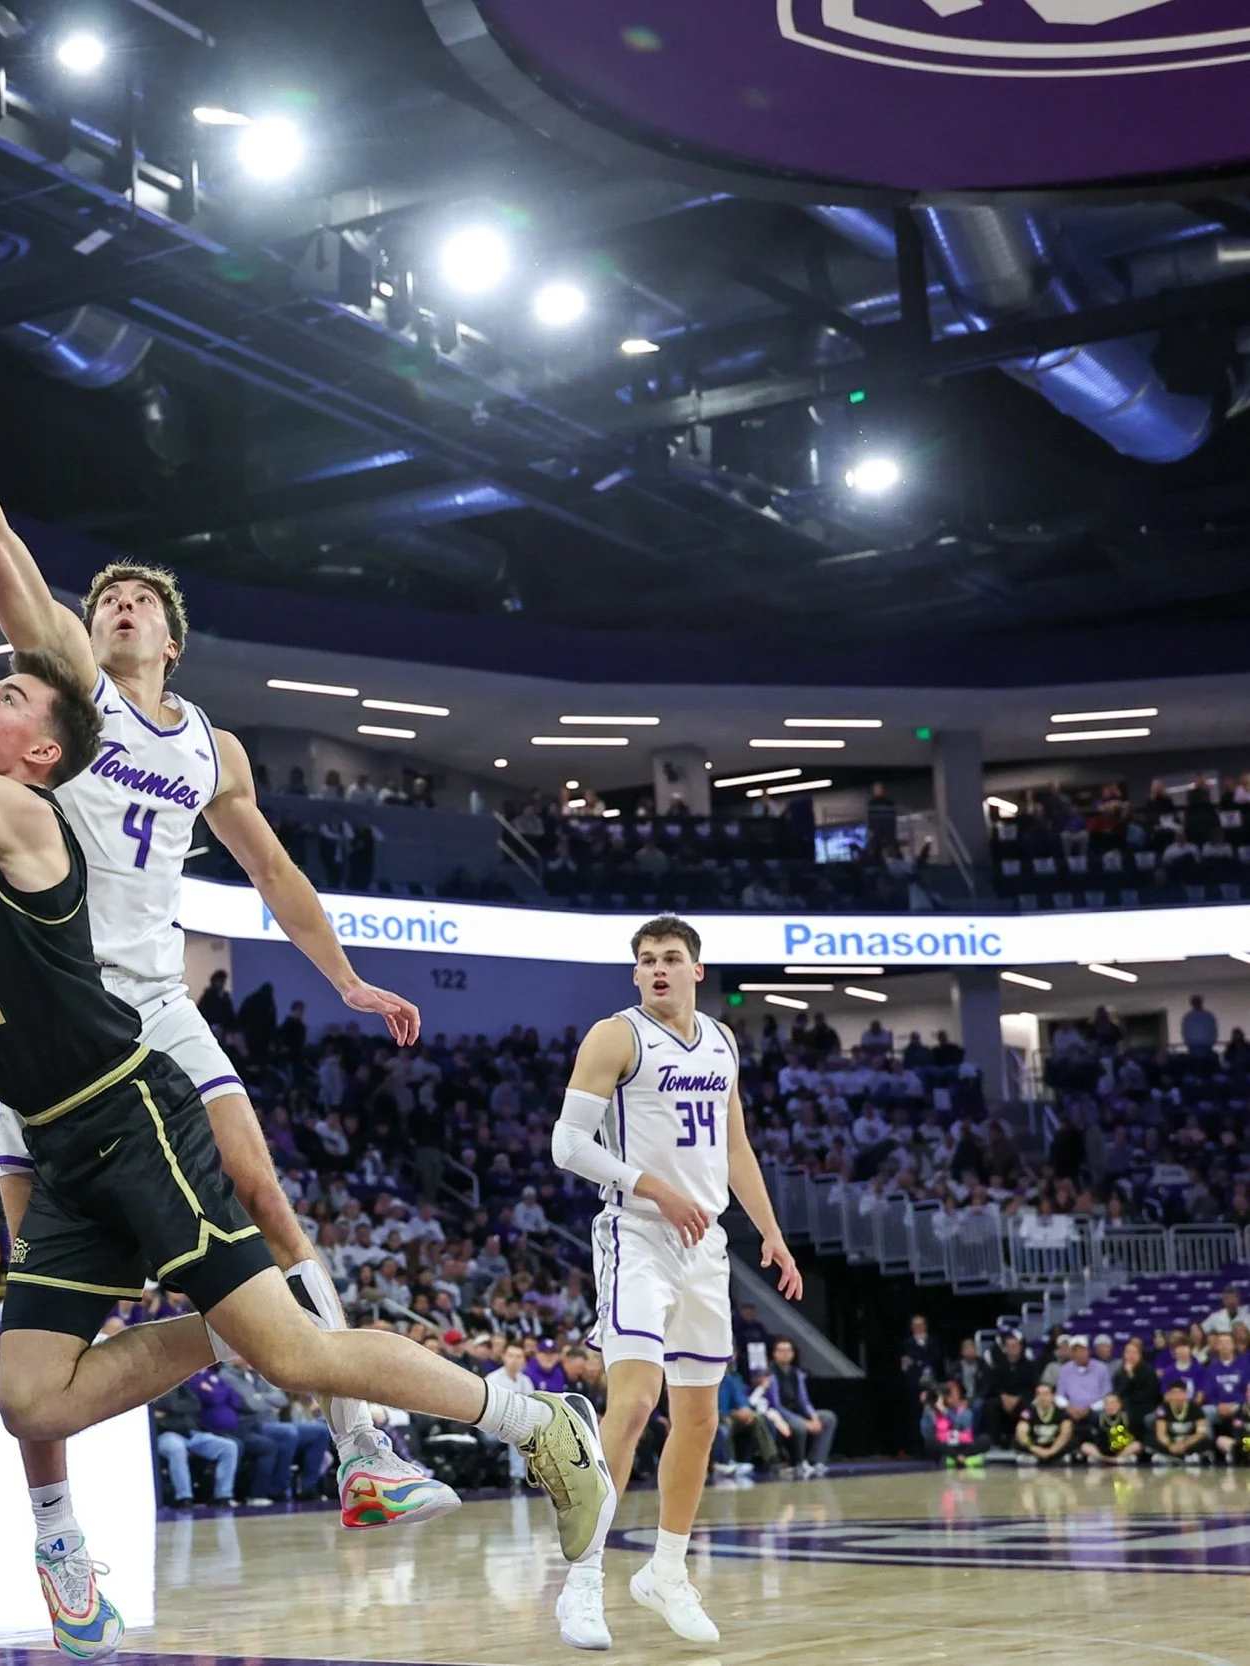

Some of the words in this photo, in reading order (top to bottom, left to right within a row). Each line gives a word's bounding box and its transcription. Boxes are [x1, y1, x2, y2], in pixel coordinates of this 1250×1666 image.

[90, 741, 200, 810] Tommies
[122, 802, 158, 871] 4
[784, 923, 1002, 956] Panasonic
[431, 967, 468, 990] 122
[658, 1065, 728, 1092] Tommies
[676, 1101, 716, 1147] 34
